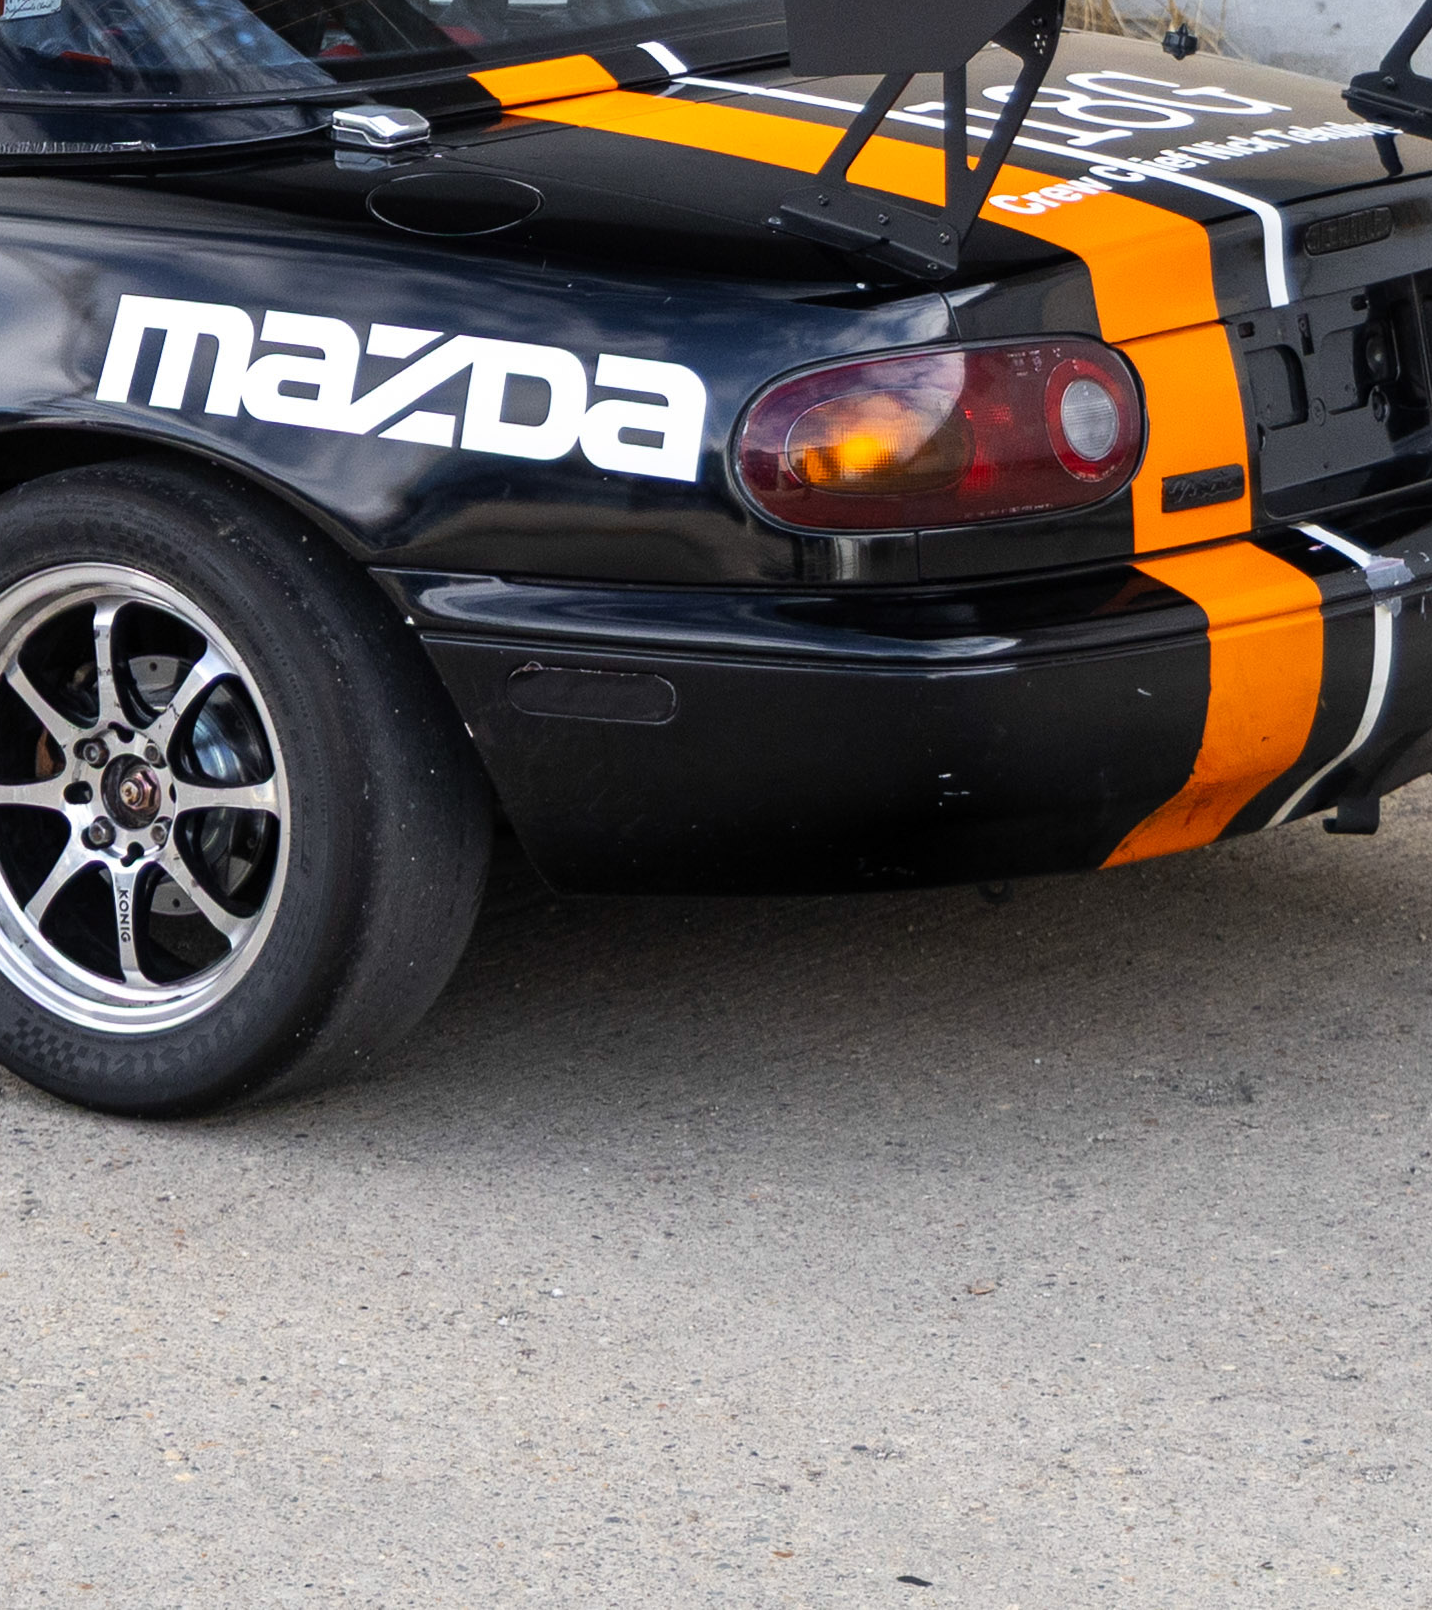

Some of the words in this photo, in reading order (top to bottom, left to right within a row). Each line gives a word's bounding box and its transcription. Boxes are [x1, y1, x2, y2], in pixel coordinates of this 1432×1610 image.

[903, 70, 1293, 147] 18G
[989, 176, 1114, 215] Crew
[1089, 148, 1210, 183] Cief
[1178, 135, 1291, 161] Nick
[118, 889, 131, 943] KONIG
